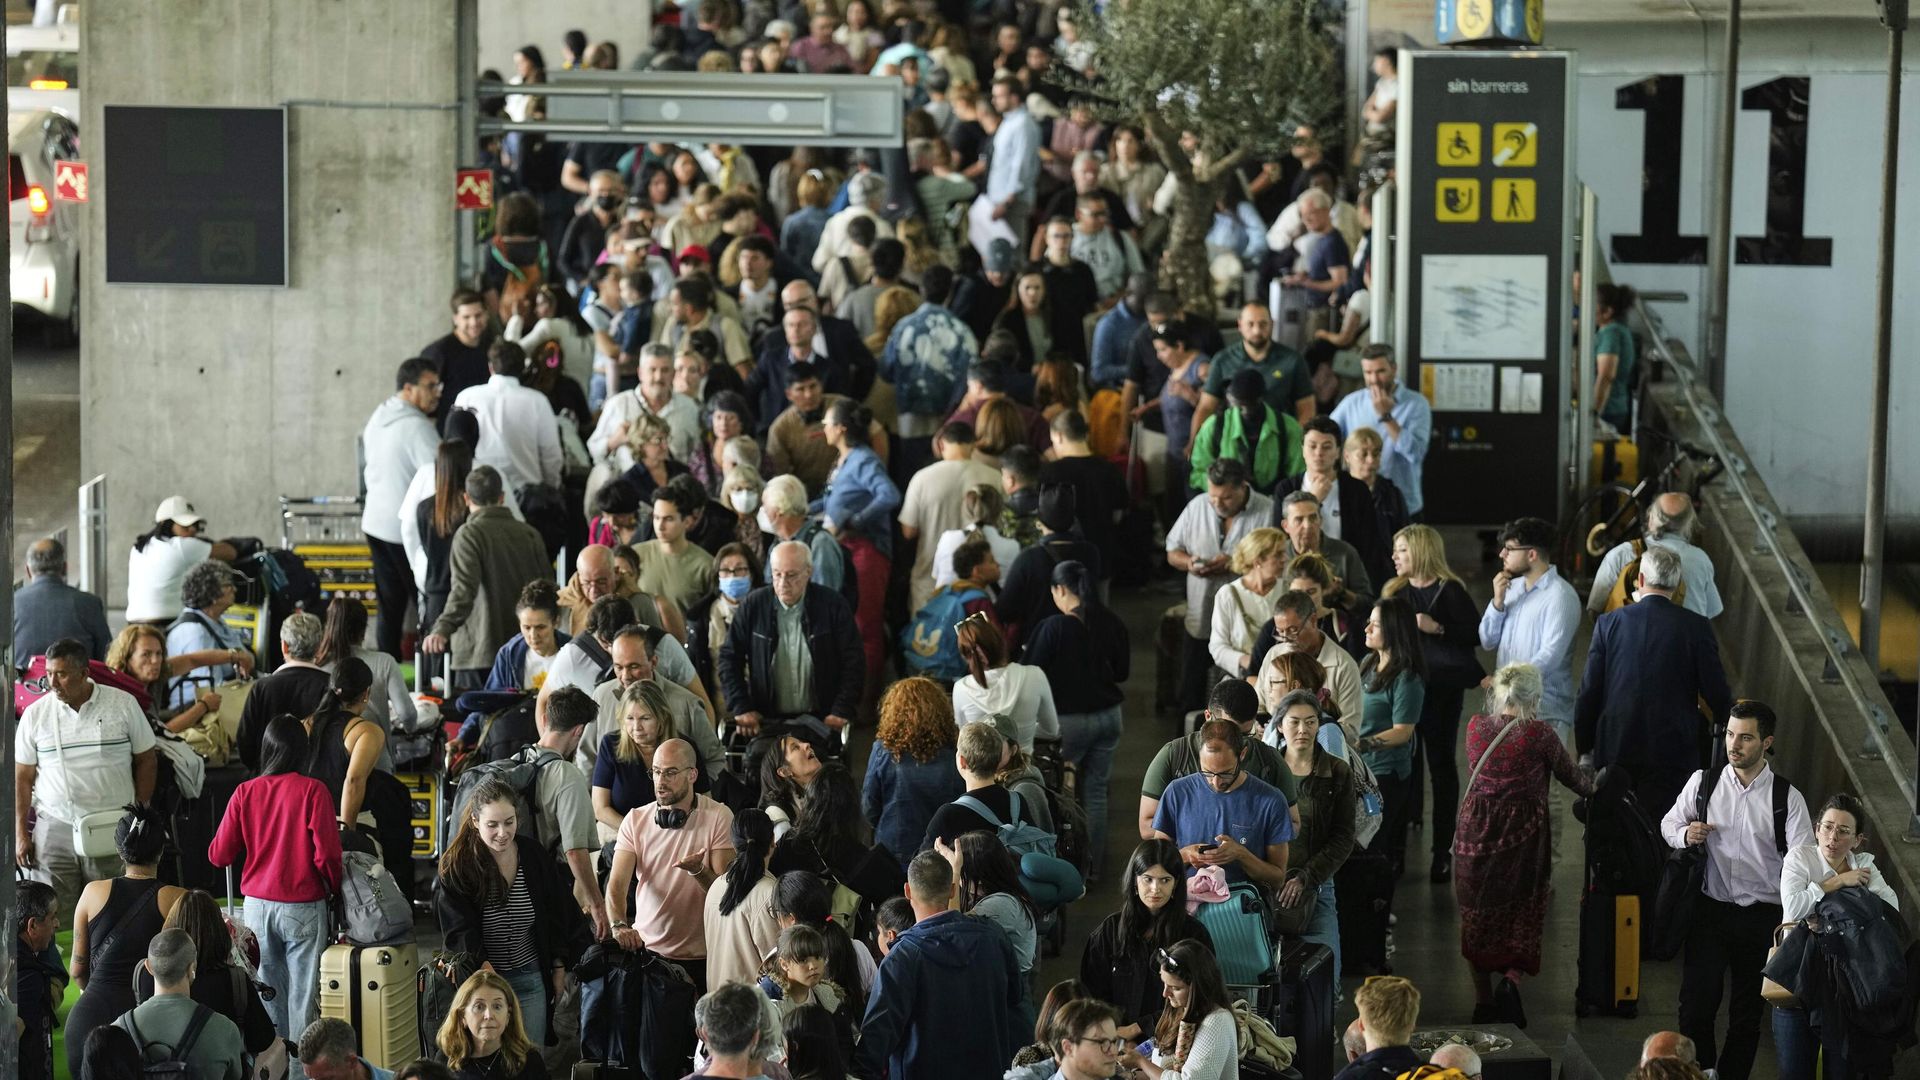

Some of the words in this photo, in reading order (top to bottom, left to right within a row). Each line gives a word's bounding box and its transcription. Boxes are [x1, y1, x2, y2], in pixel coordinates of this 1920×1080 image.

[1447, 78, 1469, 93] sin
[1470, 78, 1529, 93] barreras
[1610, 73, 1833, 267] 11
